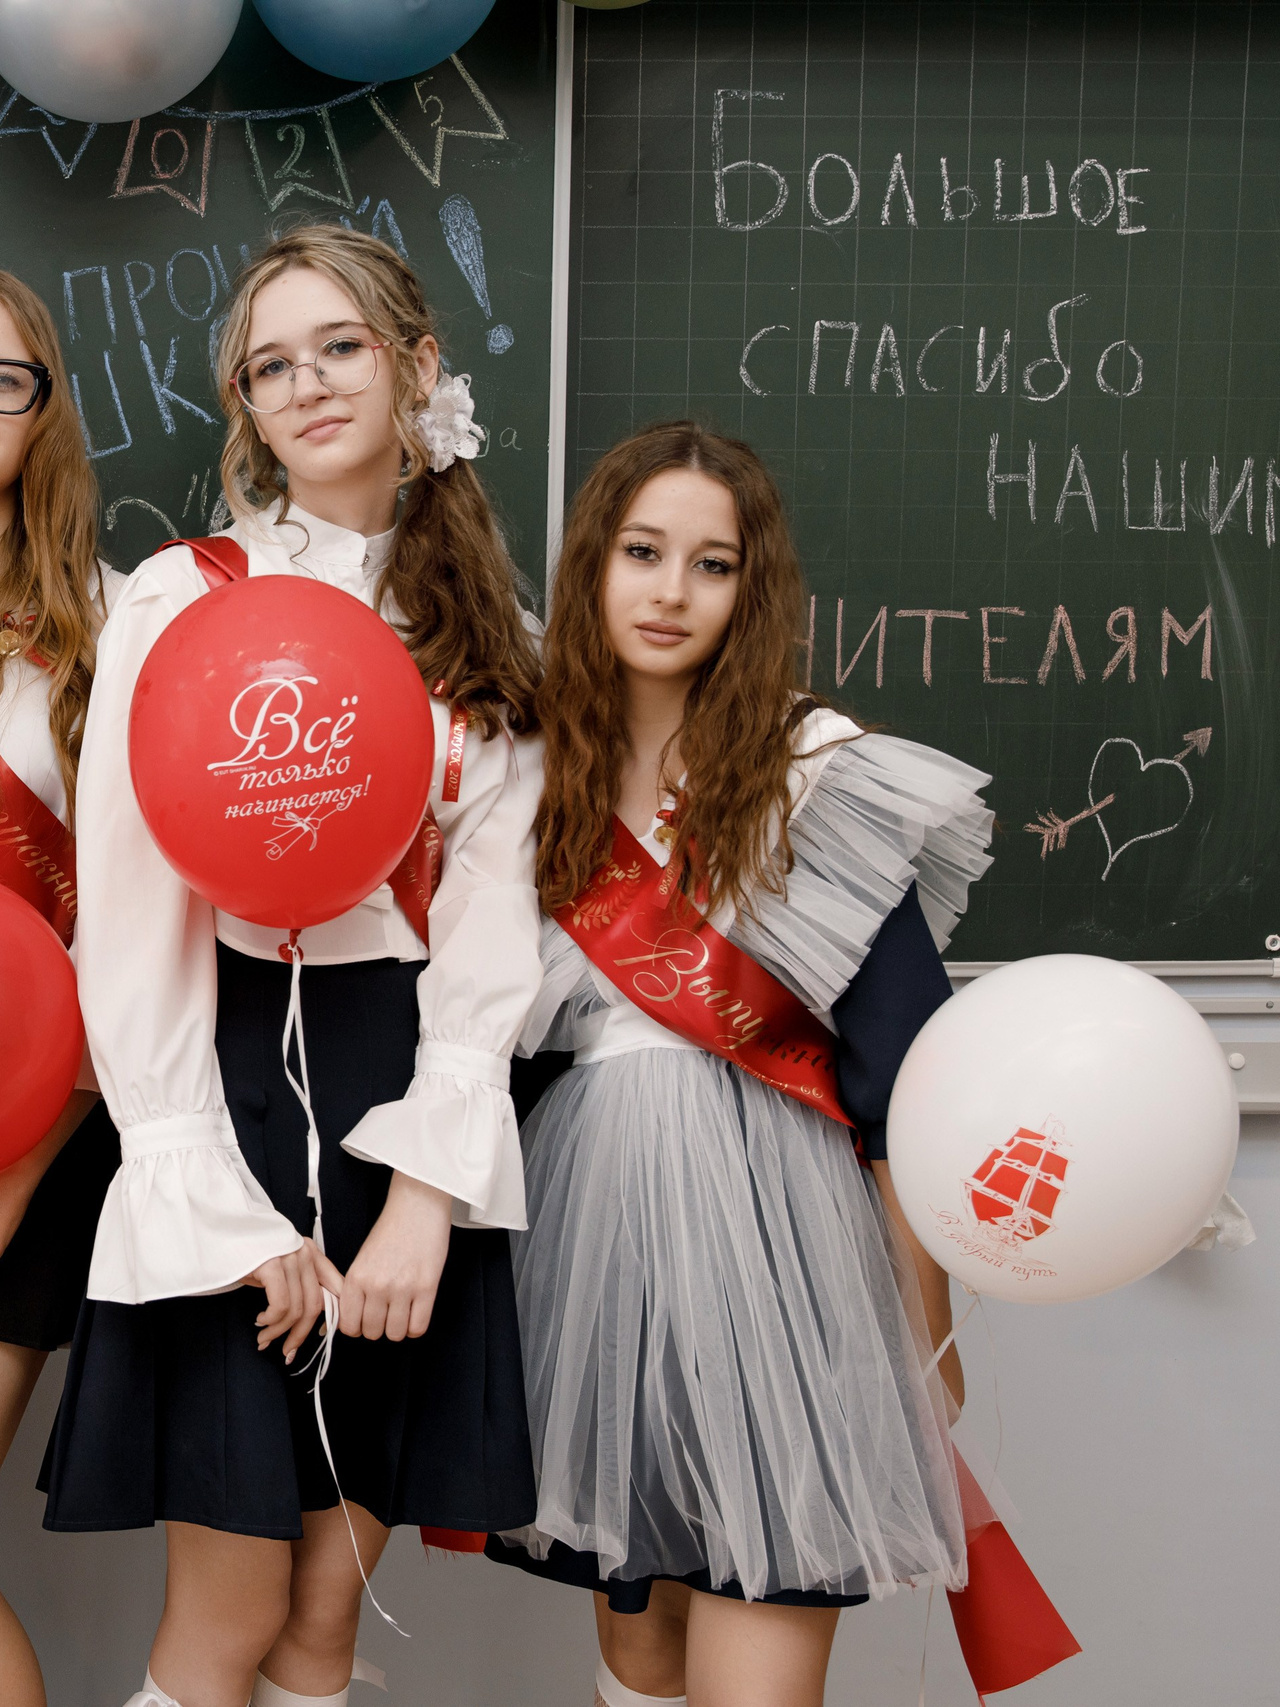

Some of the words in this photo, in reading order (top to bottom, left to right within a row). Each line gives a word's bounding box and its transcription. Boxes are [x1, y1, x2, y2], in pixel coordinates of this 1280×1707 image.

[207, 675, 359, 771] Всё
[238, 740, 351, 791] только
[224, 774, 372, 819] начинается!
[1010, 1265, 1058, 1282] путь
